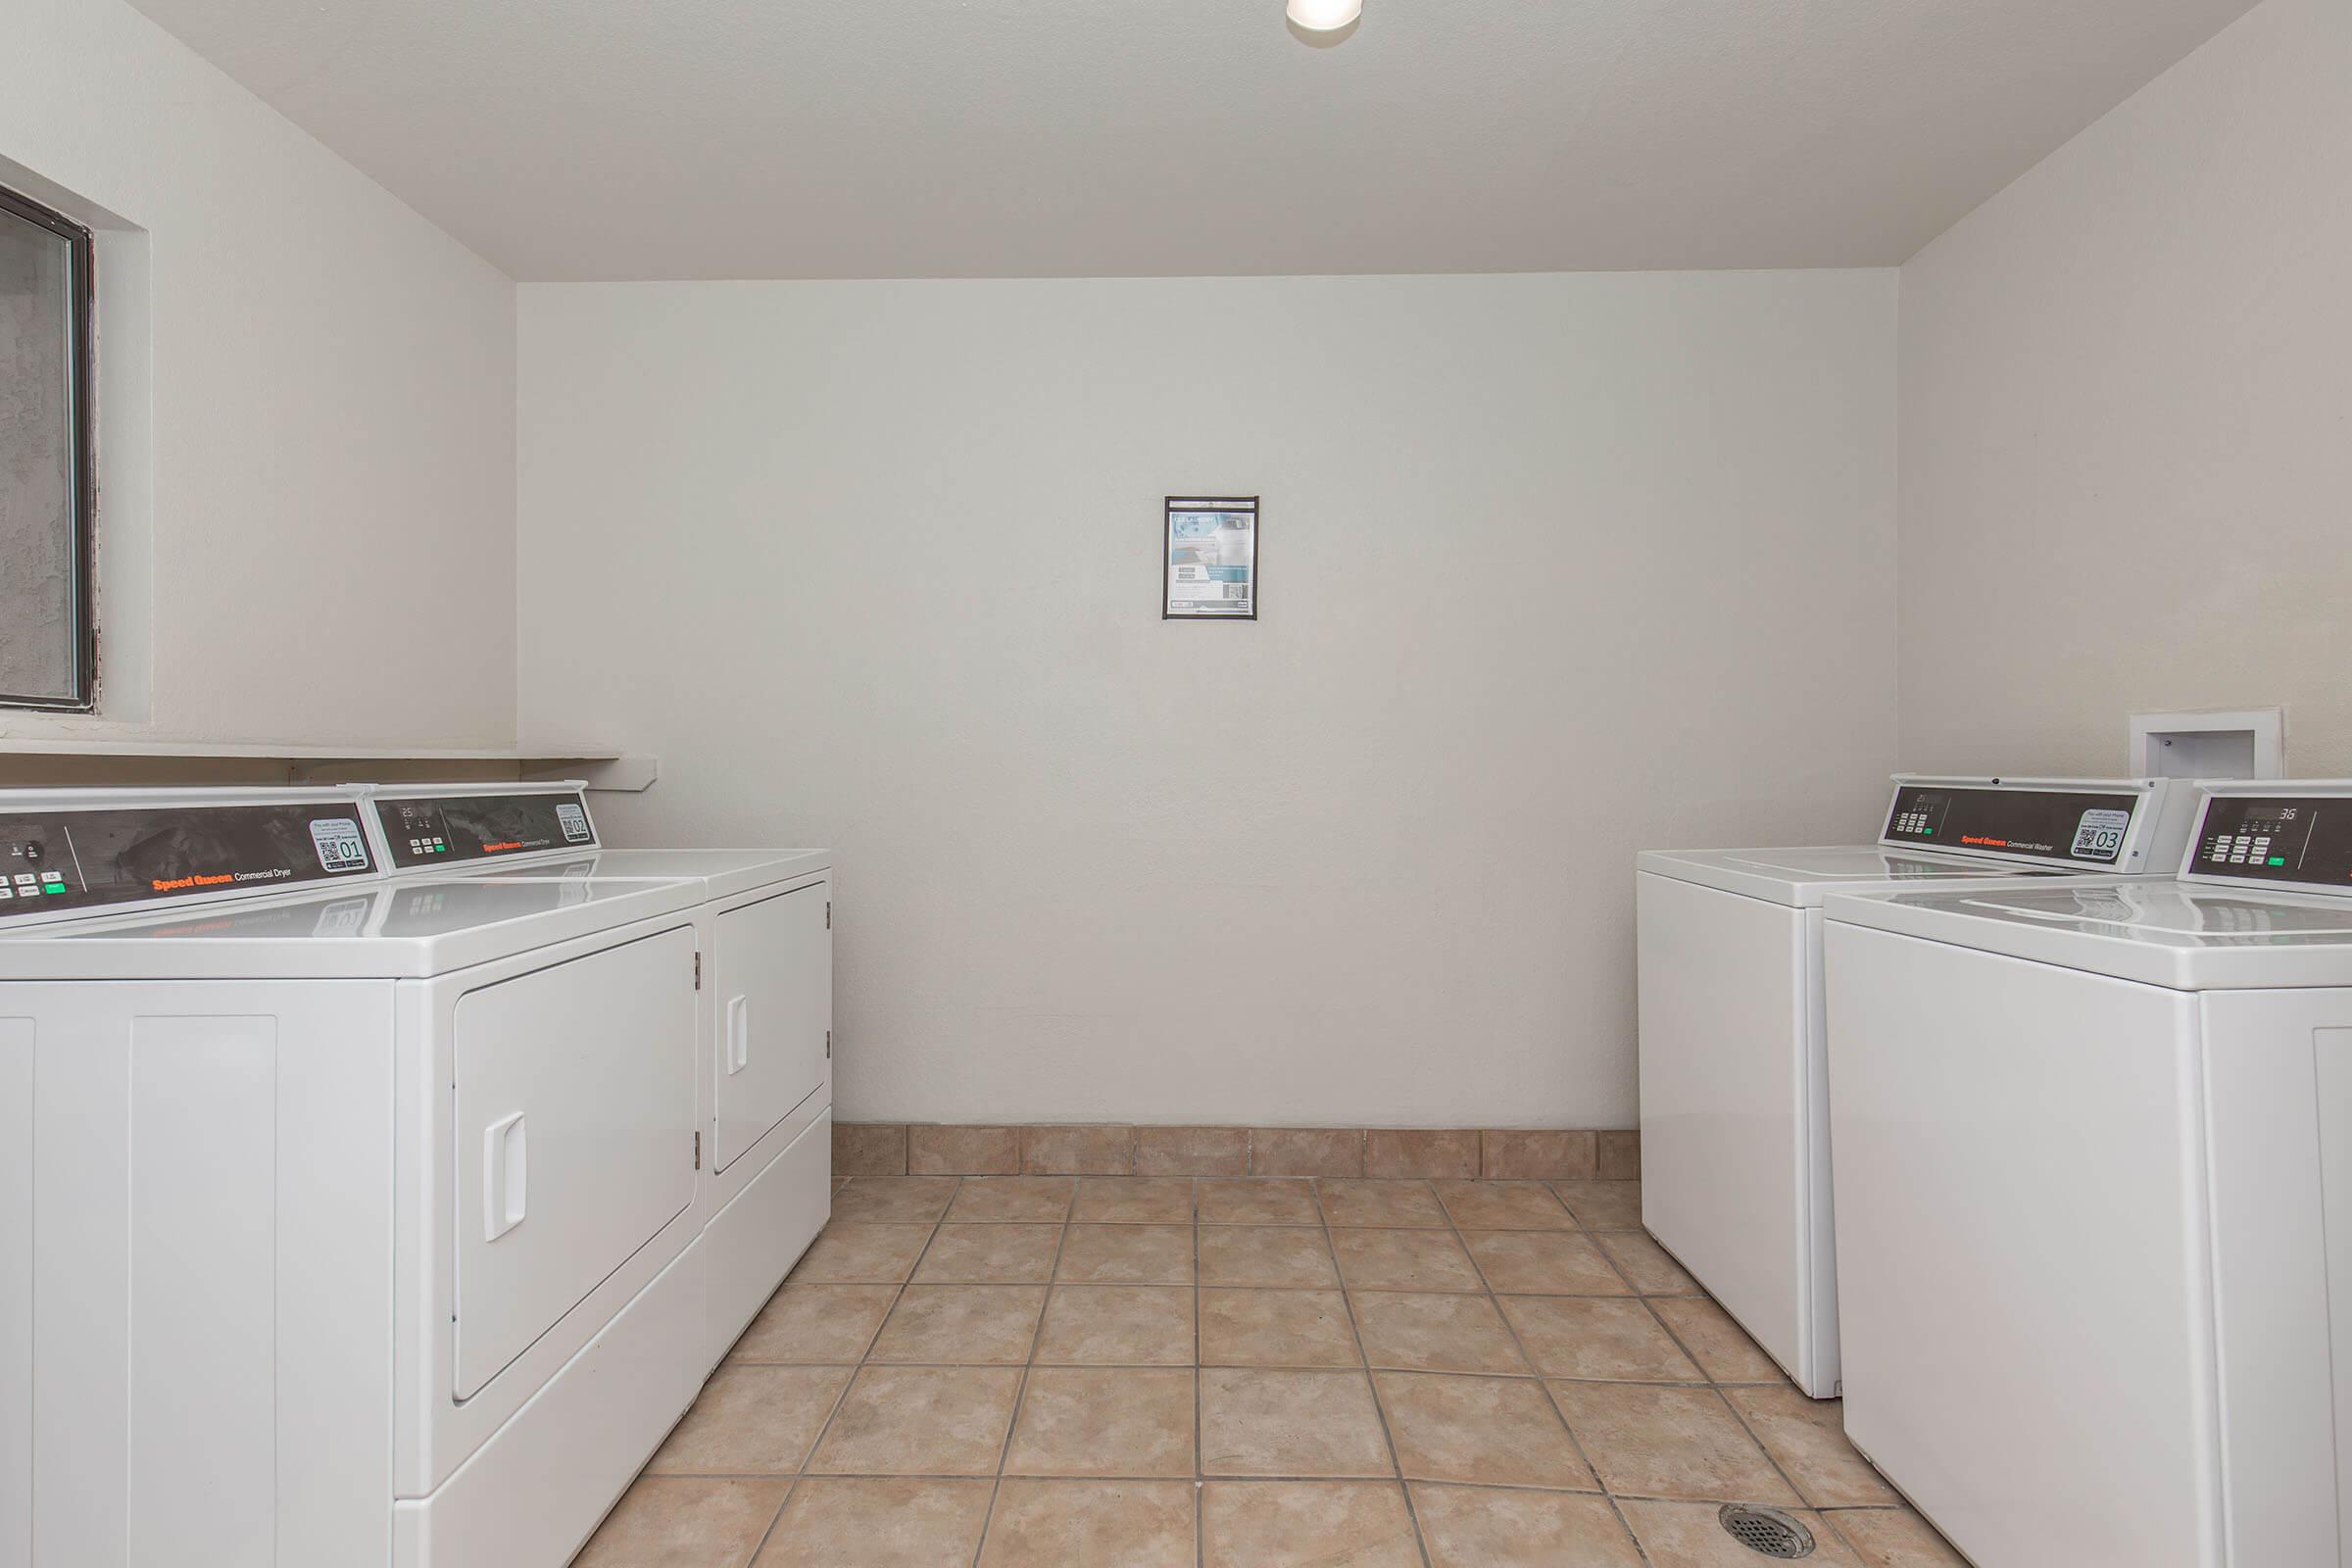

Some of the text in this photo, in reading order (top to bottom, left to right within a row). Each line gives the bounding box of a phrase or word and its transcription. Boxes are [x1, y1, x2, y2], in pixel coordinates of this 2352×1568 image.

[2278, 808, 2297, 820] 36
[572, 820, 586, 833] 02
[2096, 831, 2119, 849] 03
[340, 841, 363, 858] 01
[153, 868, 292, 892] Speed Queen Commercial Dryer
